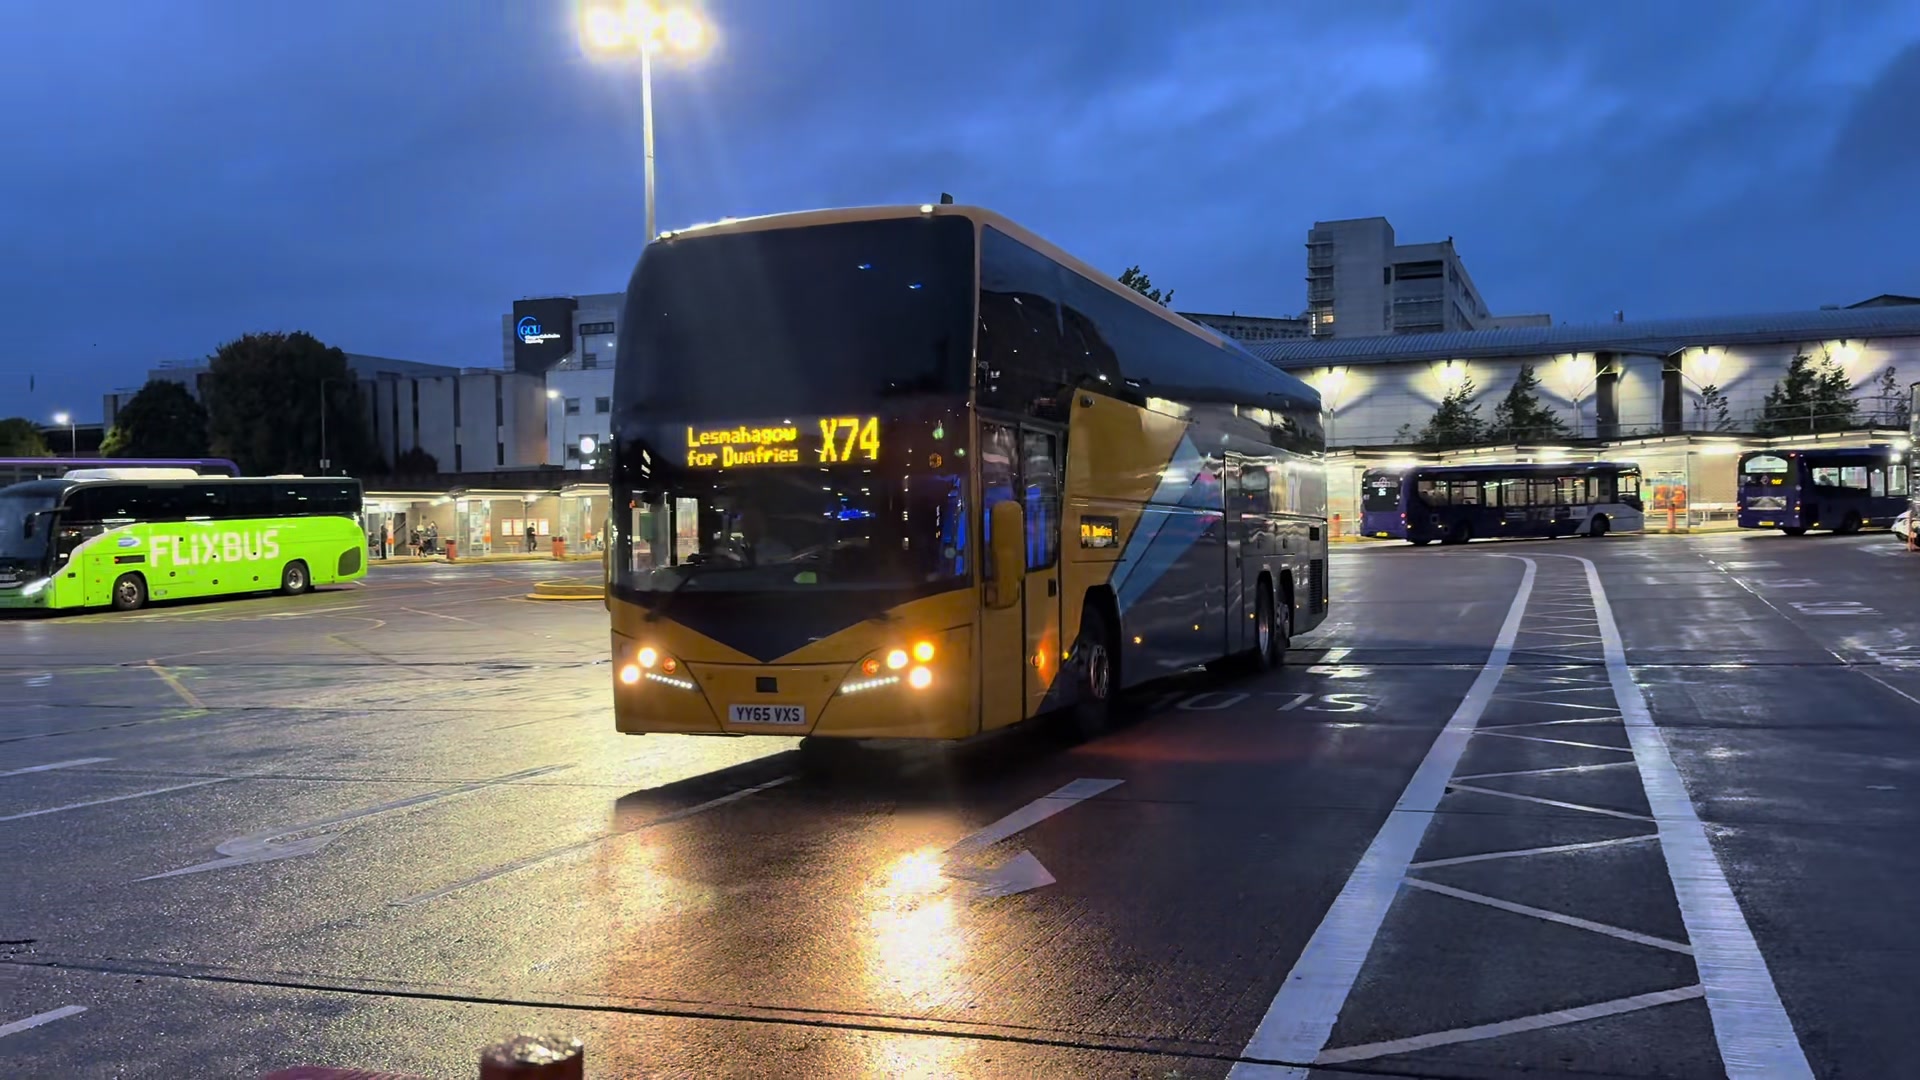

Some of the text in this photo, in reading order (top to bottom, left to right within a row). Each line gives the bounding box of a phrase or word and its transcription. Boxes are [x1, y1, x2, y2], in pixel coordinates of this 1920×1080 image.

[687, 426, 798, 448] Lesmahagow
[819, 416, 881, 462] X74
[688, 445, 799, 467] for Dumfries
[736, 706, 800, 722] YY65 VXS
